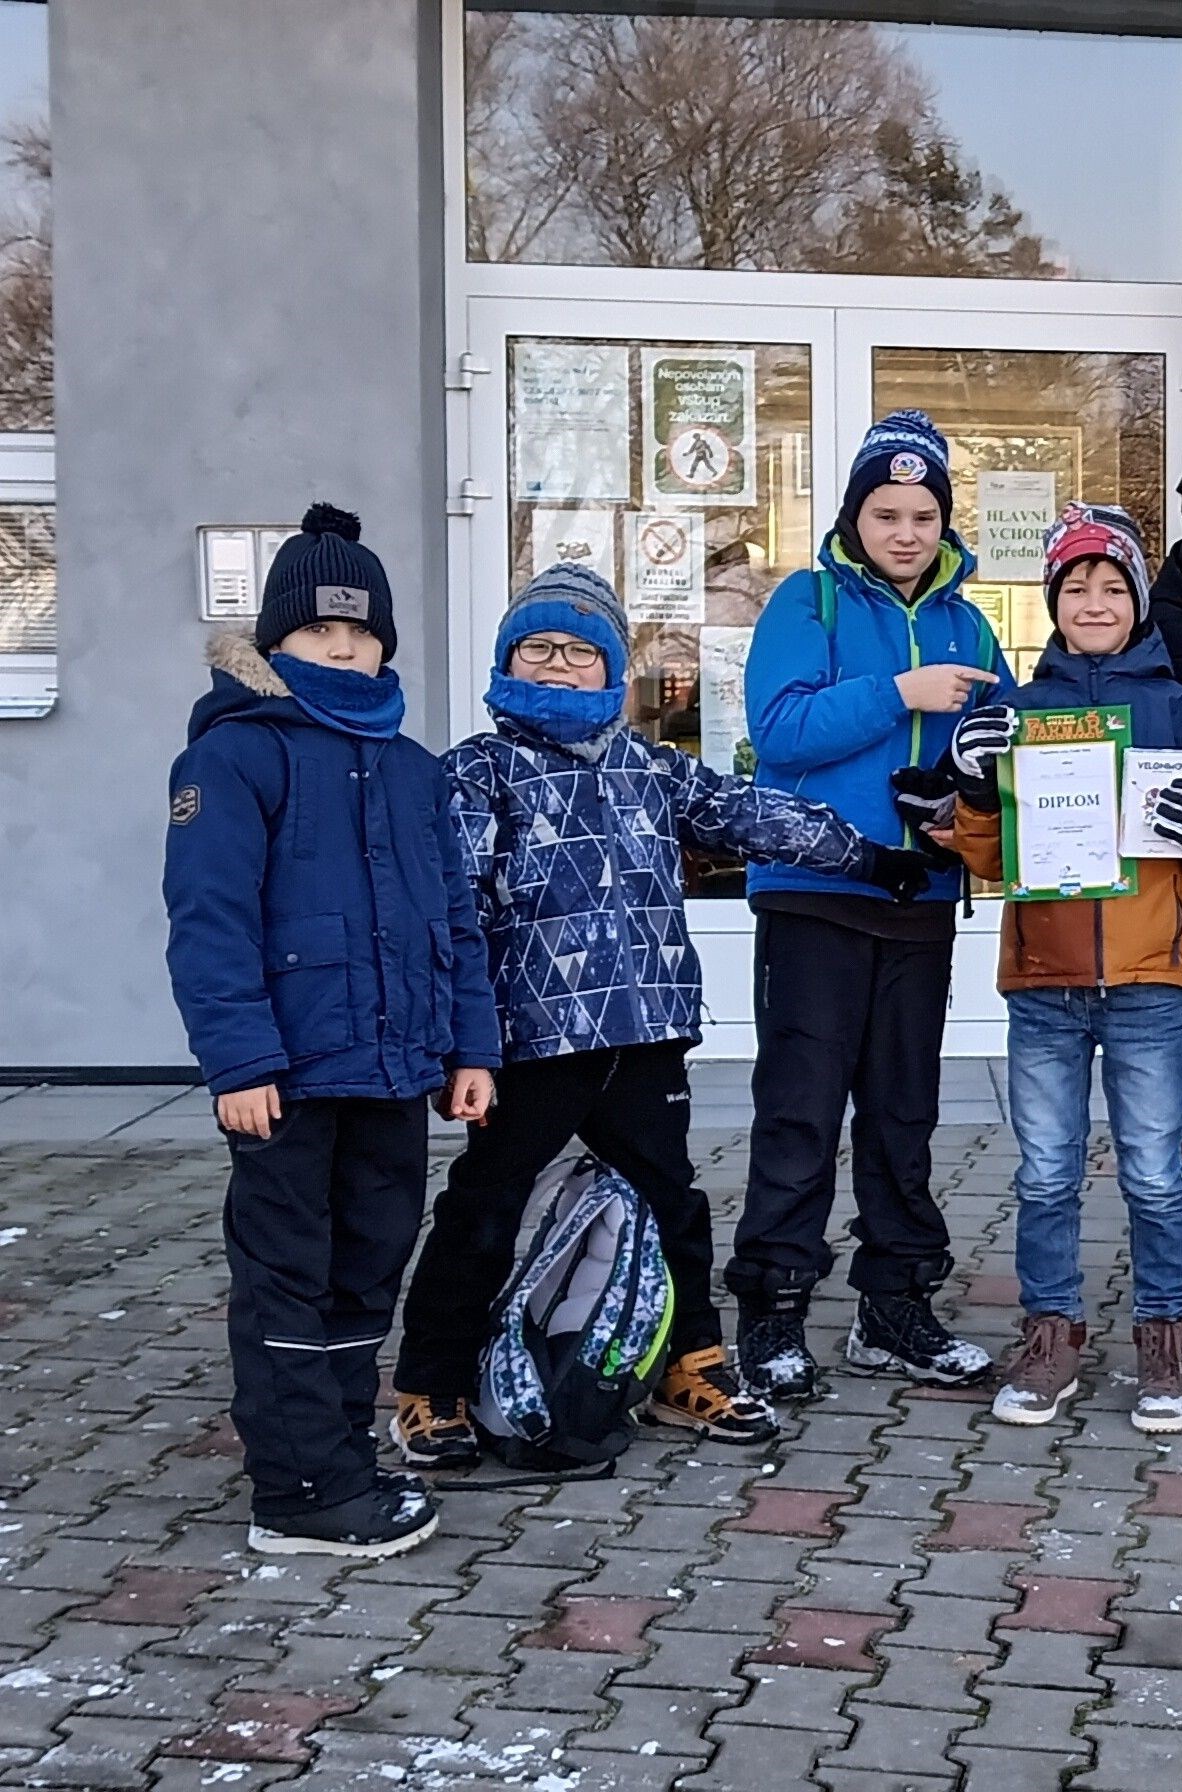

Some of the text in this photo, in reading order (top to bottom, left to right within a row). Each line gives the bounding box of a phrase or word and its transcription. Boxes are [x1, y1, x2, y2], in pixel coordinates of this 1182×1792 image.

[986, 508, 1047, 523] HLAVNÍ
[990, 546, 1044, 561] (přední)
[1038, 793, 1101, 809] DIPLOM
